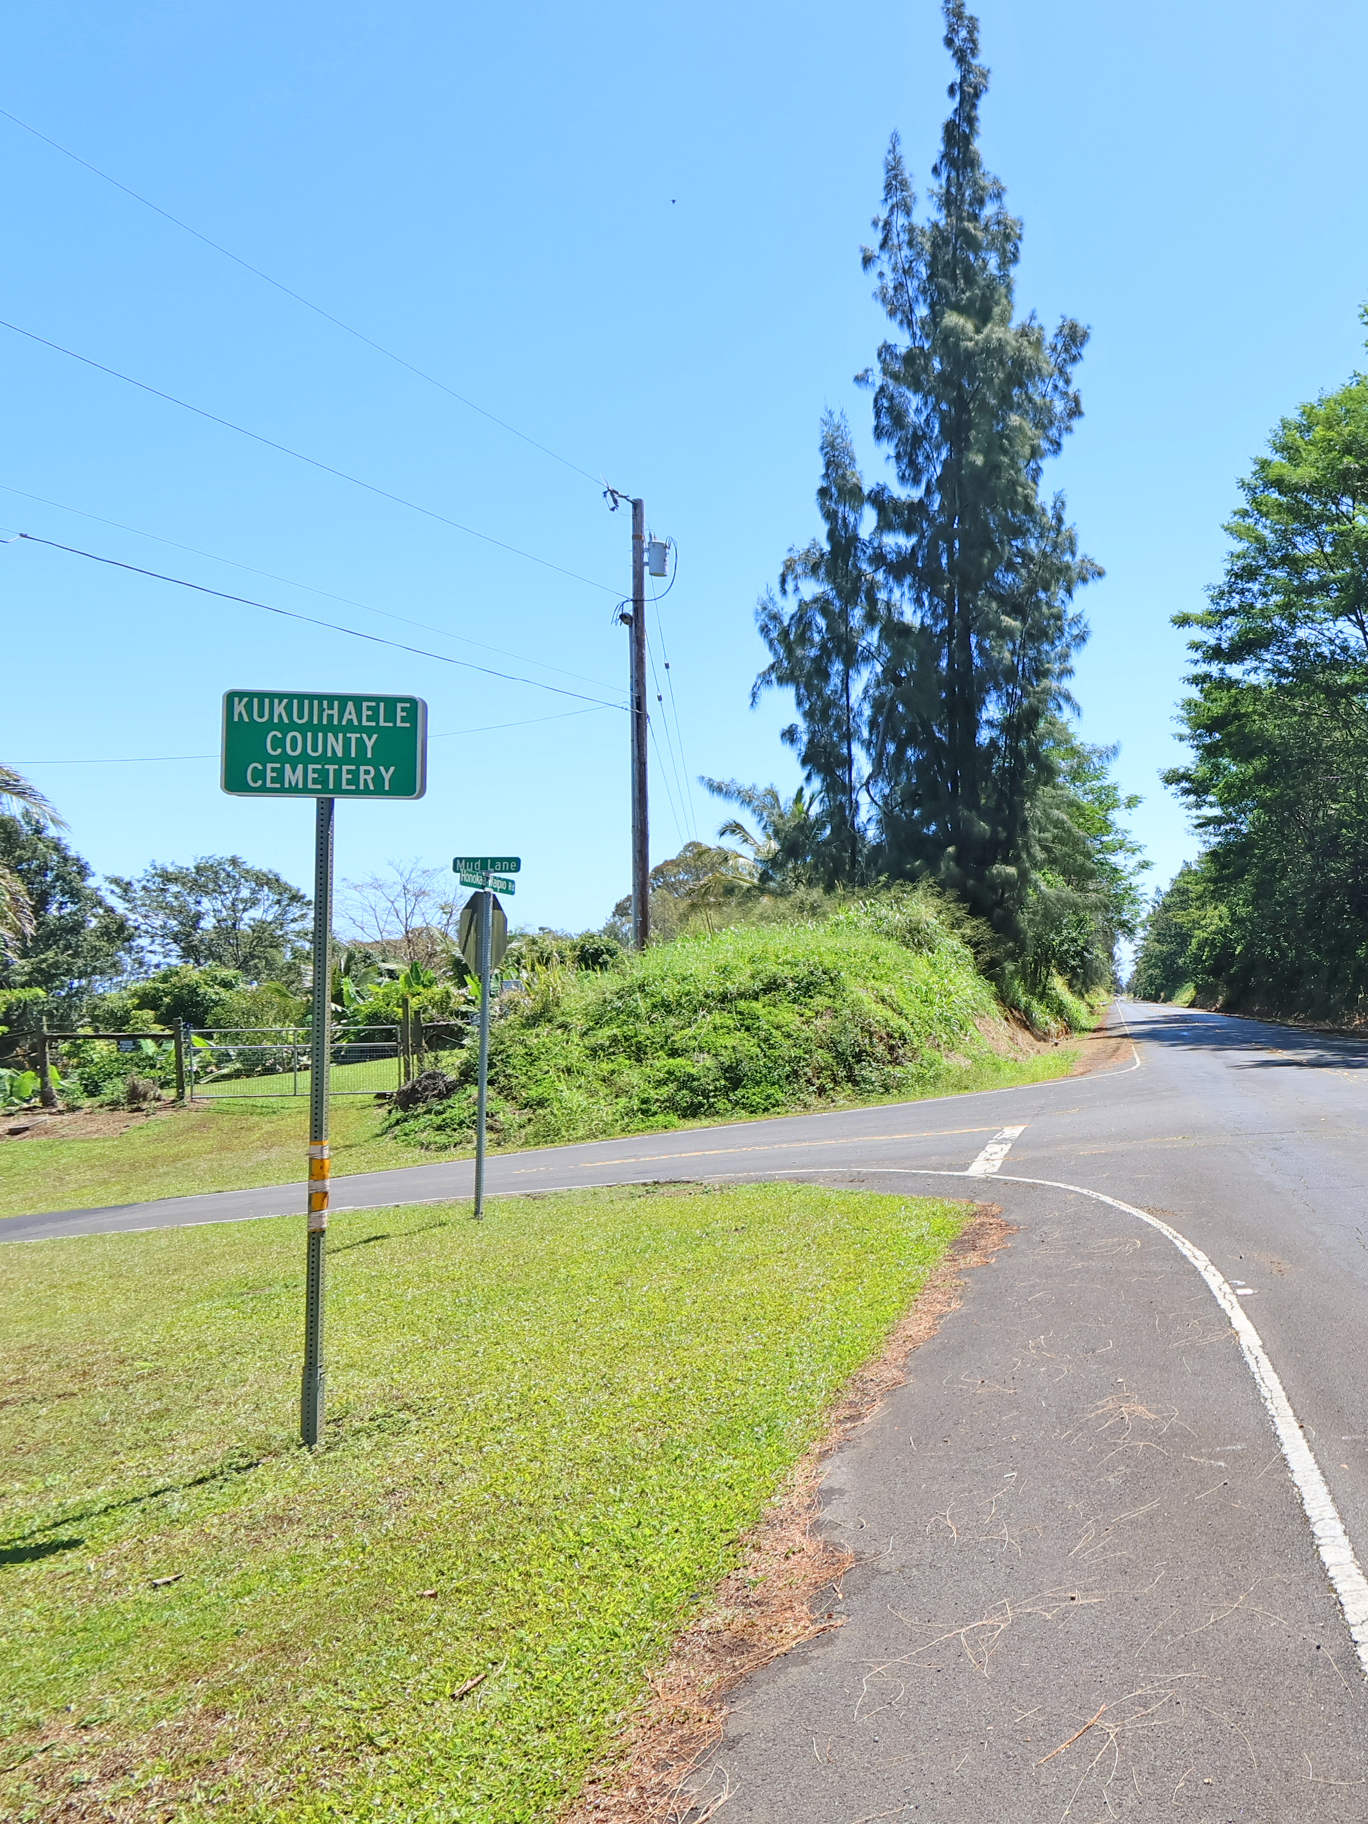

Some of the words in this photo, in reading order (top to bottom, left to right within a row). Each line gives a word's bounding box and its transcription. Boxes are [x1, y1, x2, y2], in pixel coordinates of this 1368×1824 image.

[233, 697, 411, 727] KUKUIHAELE
[266, 730, 378, 758] COUNTY
[246, 762, 395, 790] CEMETERY
[456, 859, 481, 871] Mud
[487, 859, 517, 871] Lane
